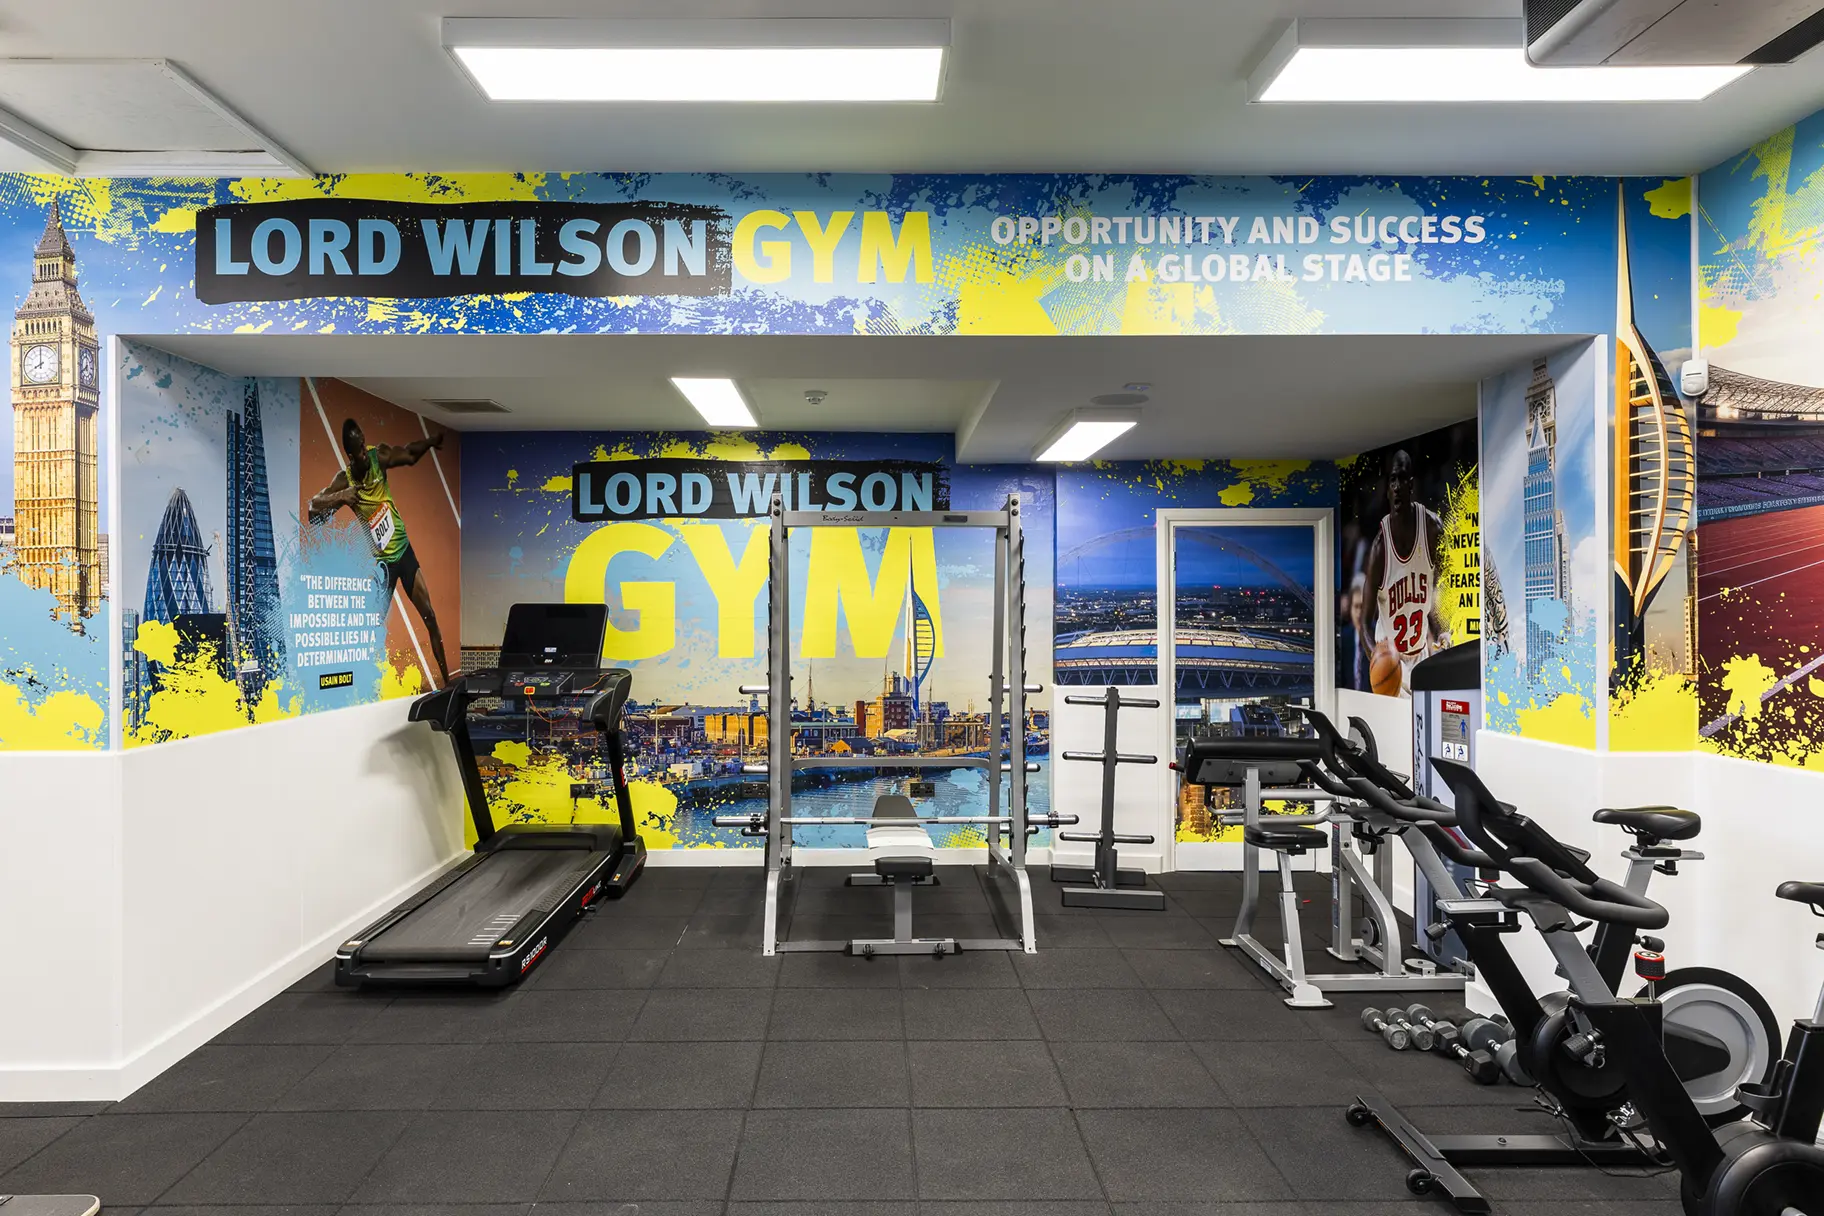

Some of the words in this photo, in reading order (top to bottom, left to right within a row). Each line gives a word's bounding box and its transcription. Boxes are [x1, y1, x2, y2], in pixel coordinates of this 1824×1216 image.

[991, 216, 1240, 245] OPPORTUNITY
[1247, 216, 1319, 244] AND
[1329, 216, 1486, 245] SUCCESS
[215, 218, 401, 276] LORD
[420, 218, 707, 277] WILSON
[732, 210, 934, 284] GYM
[1065, 253, 1114, 283] ON
[1125, 254, 1148, 282] A
[1157, 254, 1296, 283] GLOBAL
[1302, 254, 1412, 283] STAGE
[579, 472, 713, 515] LORD
[726, 472, 933, 514] WILSON
[375, 515, 390, 541] BOLT
[1453, 532, 1480, 549] NEVE
[324, 577, 372, 592] DIFFERENCE
[565, 522, 944, 660] GYM
[1450, 572, 1480, 589] FEARS
[308, 594, 348, 609] BETWEEN
[350, 595, 366, 609] THE
[1388, 572, 1427, 618] BULLS
[1458, 593, 1473, 608] AN
[289, 613, 346, 629] IMPOSSIBLE
[347, 613, 364, 627] AND
[366, 613, 380, 626] THE
[1393, 609, 1423, 652] 23
[295, 631, 340, 648] POSSIBLE
[341, 630, 359, 645] LIES
[360, 630, 369, 643] IN
[370, 630, 376, 643] A
[297, 647, 374, 668] DETERMINATION.”
[320, 677, 338, 687] USAIN
[338, 674, 353, 684] BOLT
